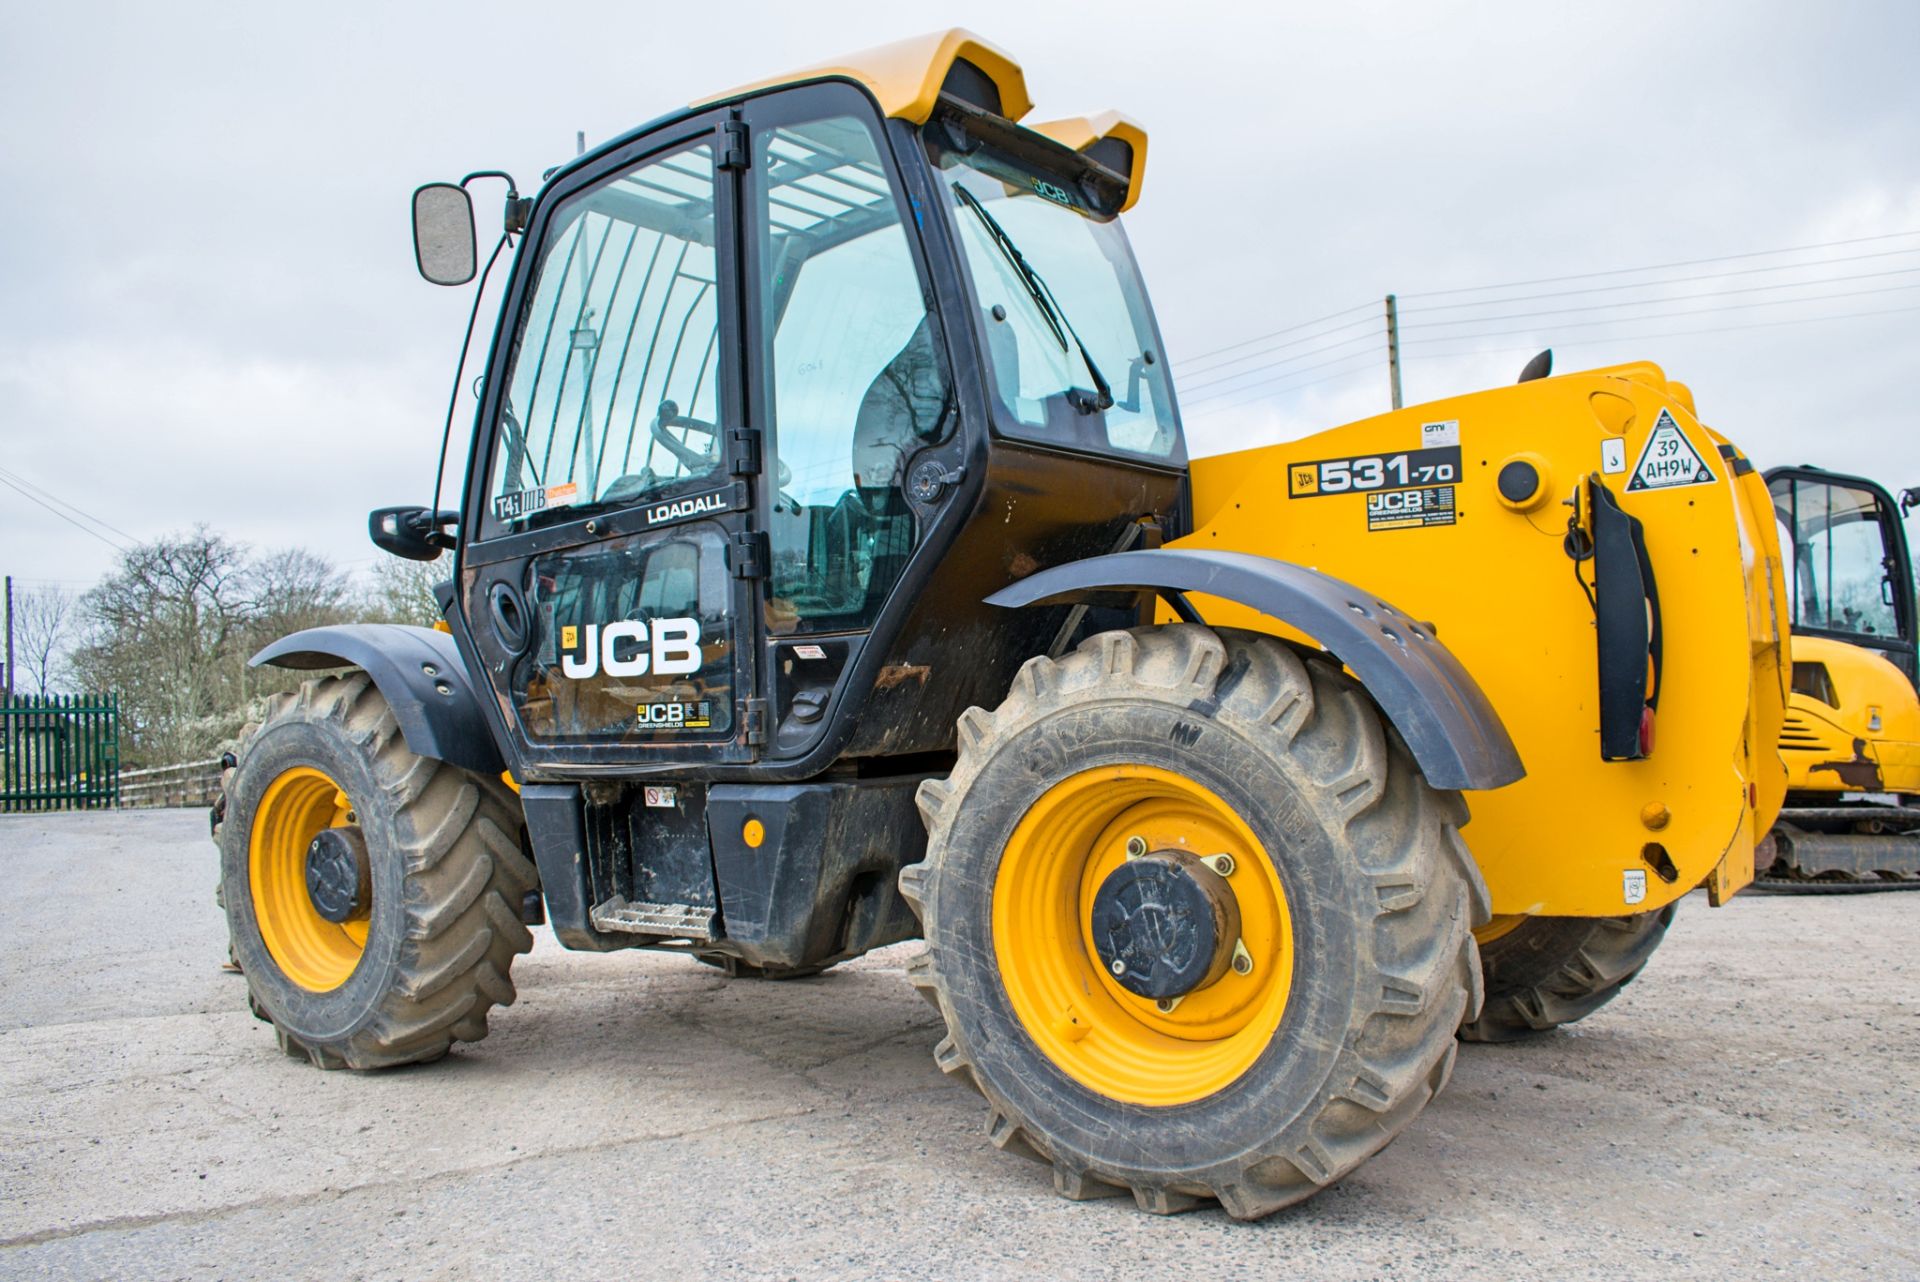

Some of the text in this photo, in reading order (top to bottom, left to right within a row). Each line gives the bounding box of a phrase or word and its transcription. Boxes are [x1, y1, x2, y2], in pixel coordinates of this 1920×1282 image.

[1034, 180, 1069, 203] JCB
[1657, 440, 1679, 457] 39
[1646, 458, 1692, 479] AH9W
[647, 493, 727, 524] LOADALL
[1368, 490, 1423, 511] JCB
[562, 617, 702, 679] JCB
[637, 703, 684, 723] JCB
